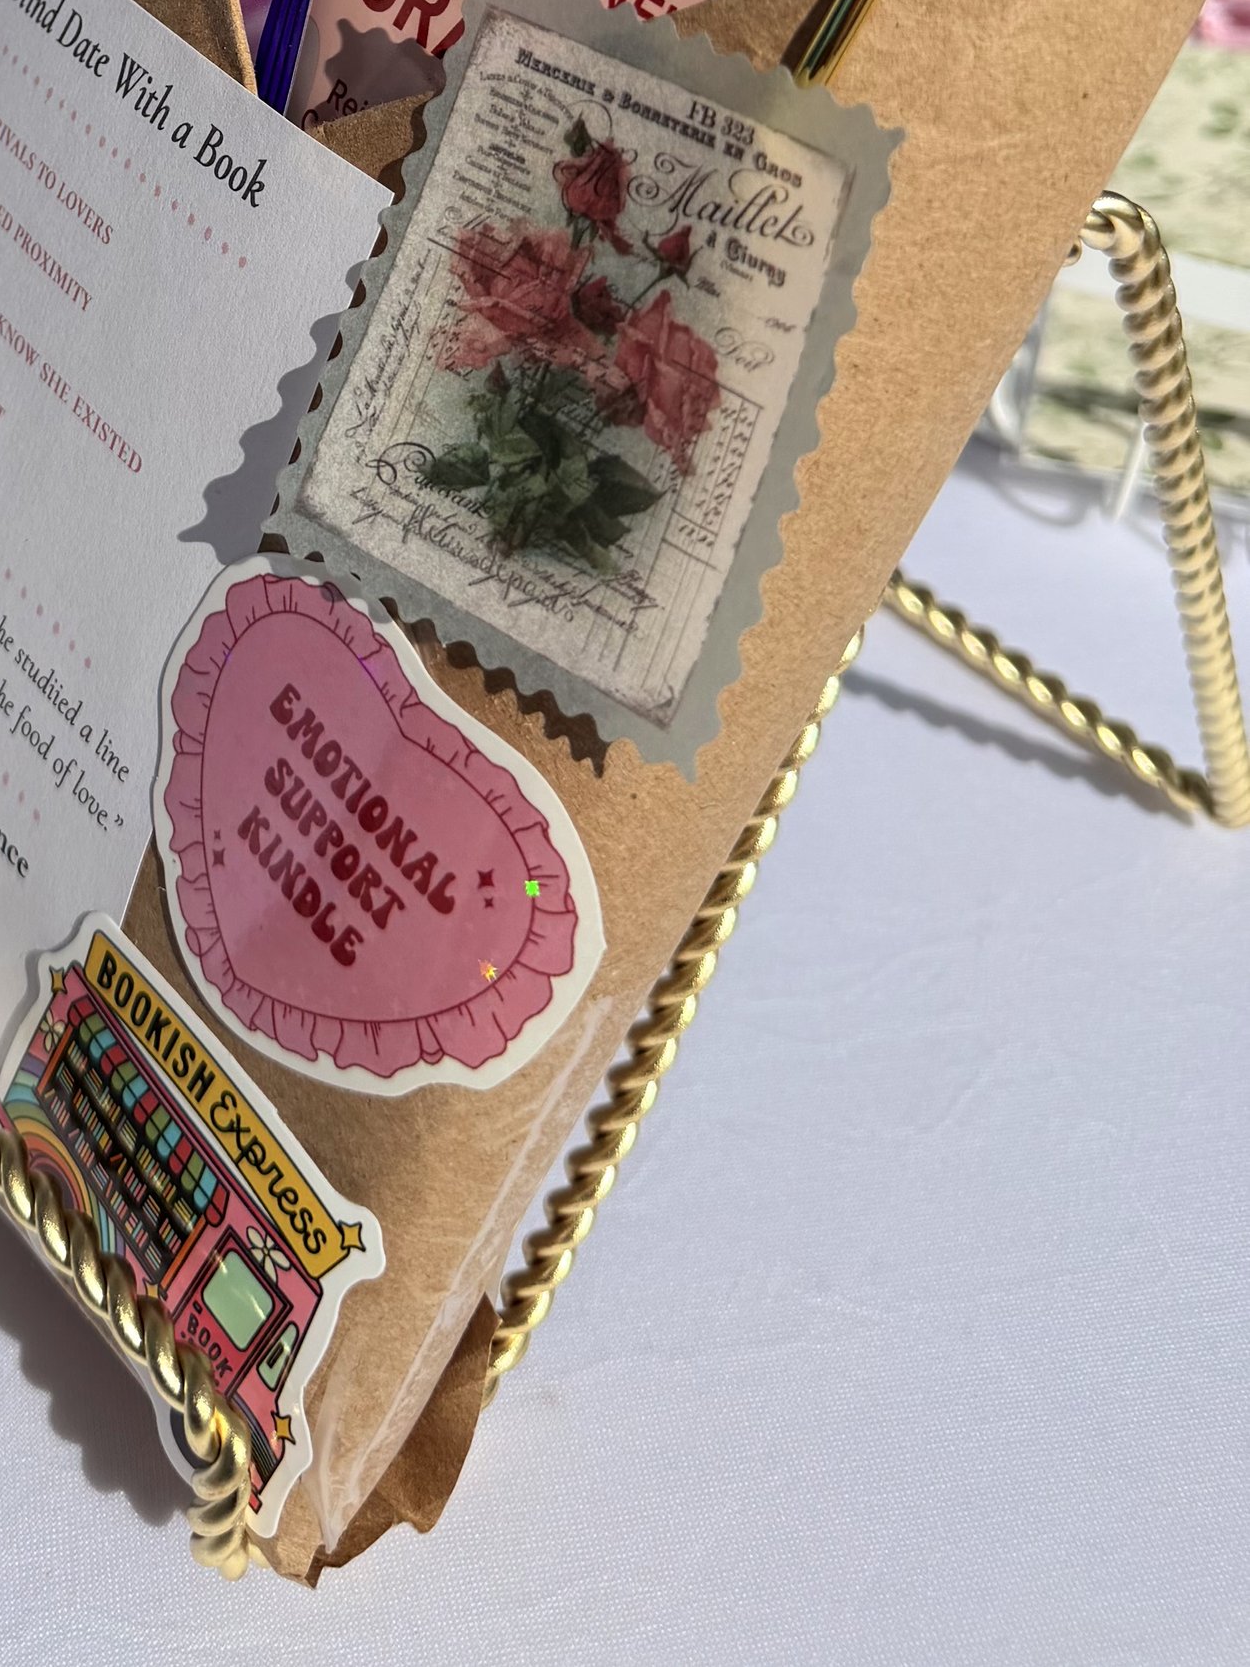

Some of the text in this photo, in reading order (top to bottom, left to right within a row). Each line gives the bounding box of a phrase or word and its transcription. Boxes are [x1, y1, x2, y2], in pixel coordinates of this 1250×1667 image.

[56, 8, 110, 77] Date
[115, 52, 173, 131] With
[171, 121, 193, 148] a
[193, 123, 267, 208] Book
[686, 99, 718, 131] FB
[37, 160, 56, 190] TO
[56, 182, 114, 245] LOVERS
[13, 224, 92, 312] PROXIMITY
[39, 362, 72, 404] SHE
[72, 394, 143, 474] EXISTED
[8, 704, 56, 763] food
[52, 757, 78, 789] of
[79, 723, 94, 744] a
[95, 728, 130, 783] line
[264, 757, 406, 930] SUPPORT
[269, 683, 456, 914] EMOTIONAL
[237, 805, 365, 967] KINDLE
[96, 950, 327, 1255] BOOKISH Express
[187, 1312, 233, 1379] BOOK
